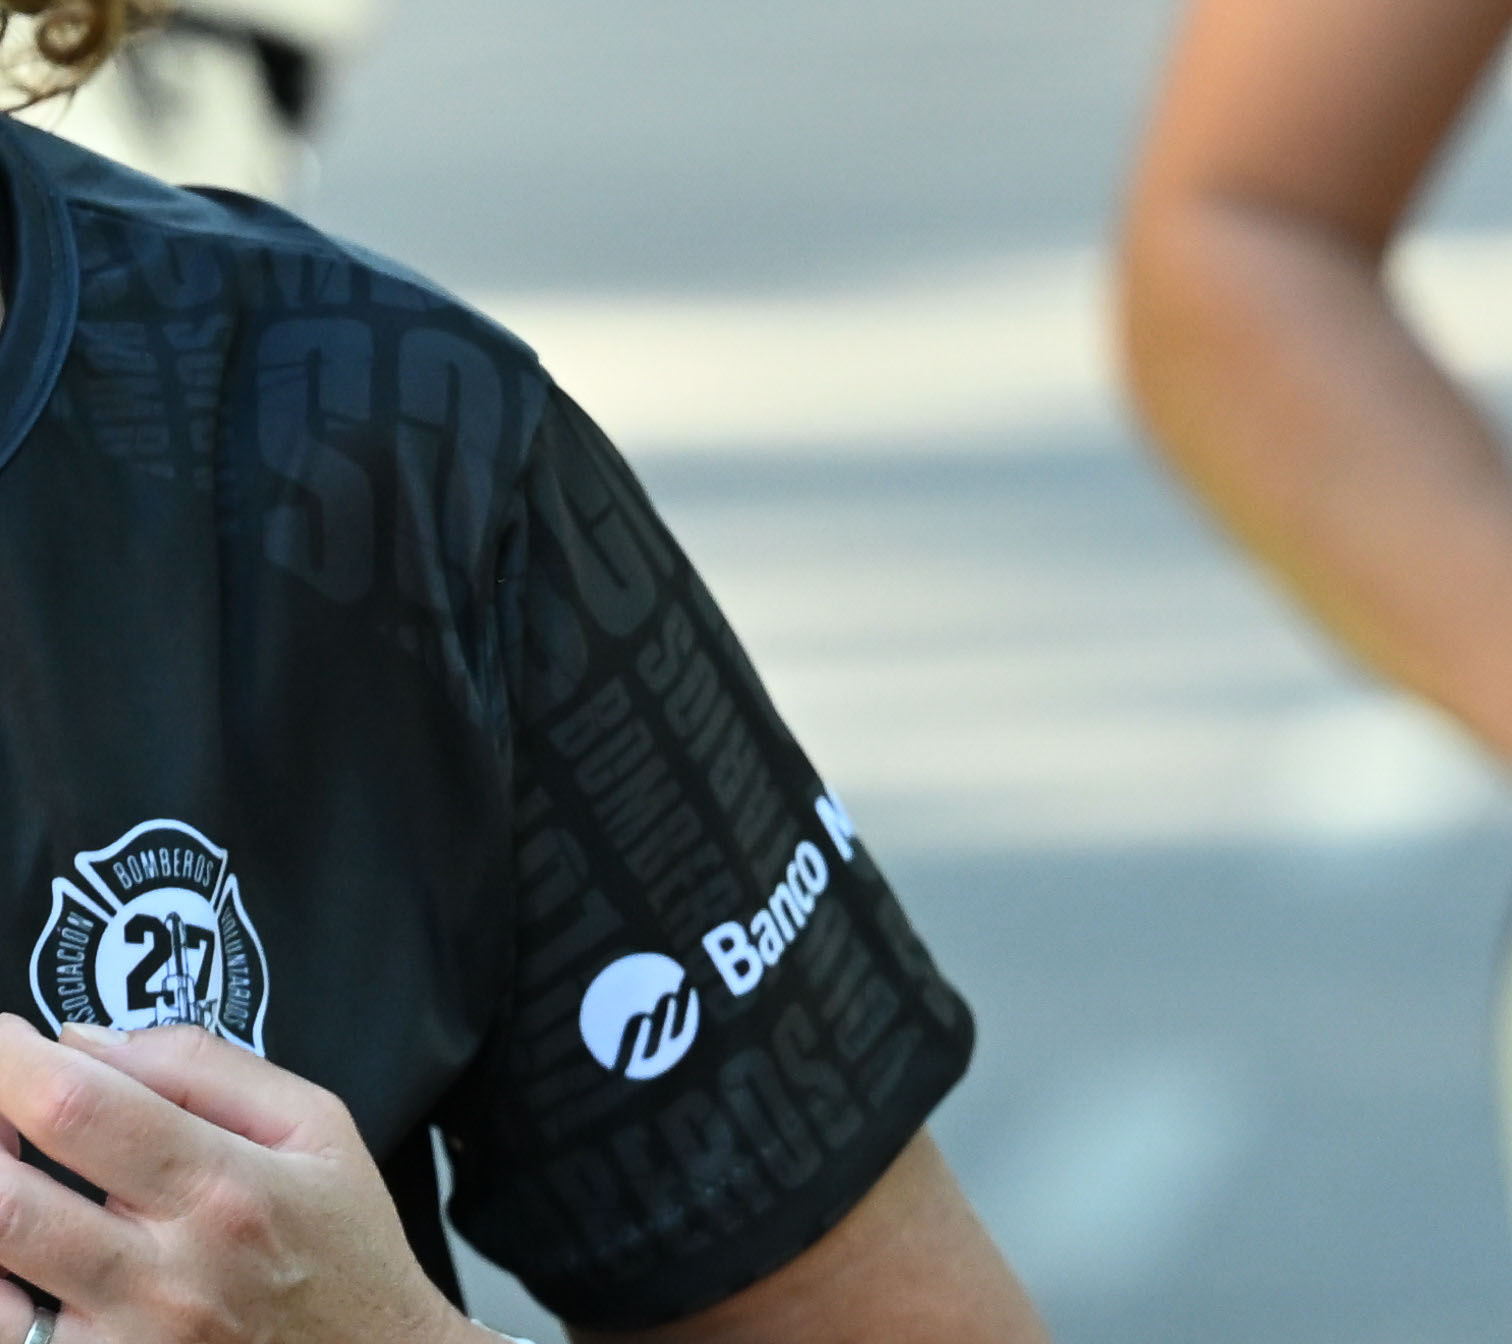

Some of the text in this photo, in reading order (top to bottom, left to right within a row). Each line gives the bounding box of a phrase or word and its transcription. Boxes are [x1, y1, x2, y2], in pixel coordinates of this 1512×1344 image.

[113, 847, 214, 890] BOMBEROS
[124, 911, 216, 1011] 27
[701, 840, 829, 998] Banco
